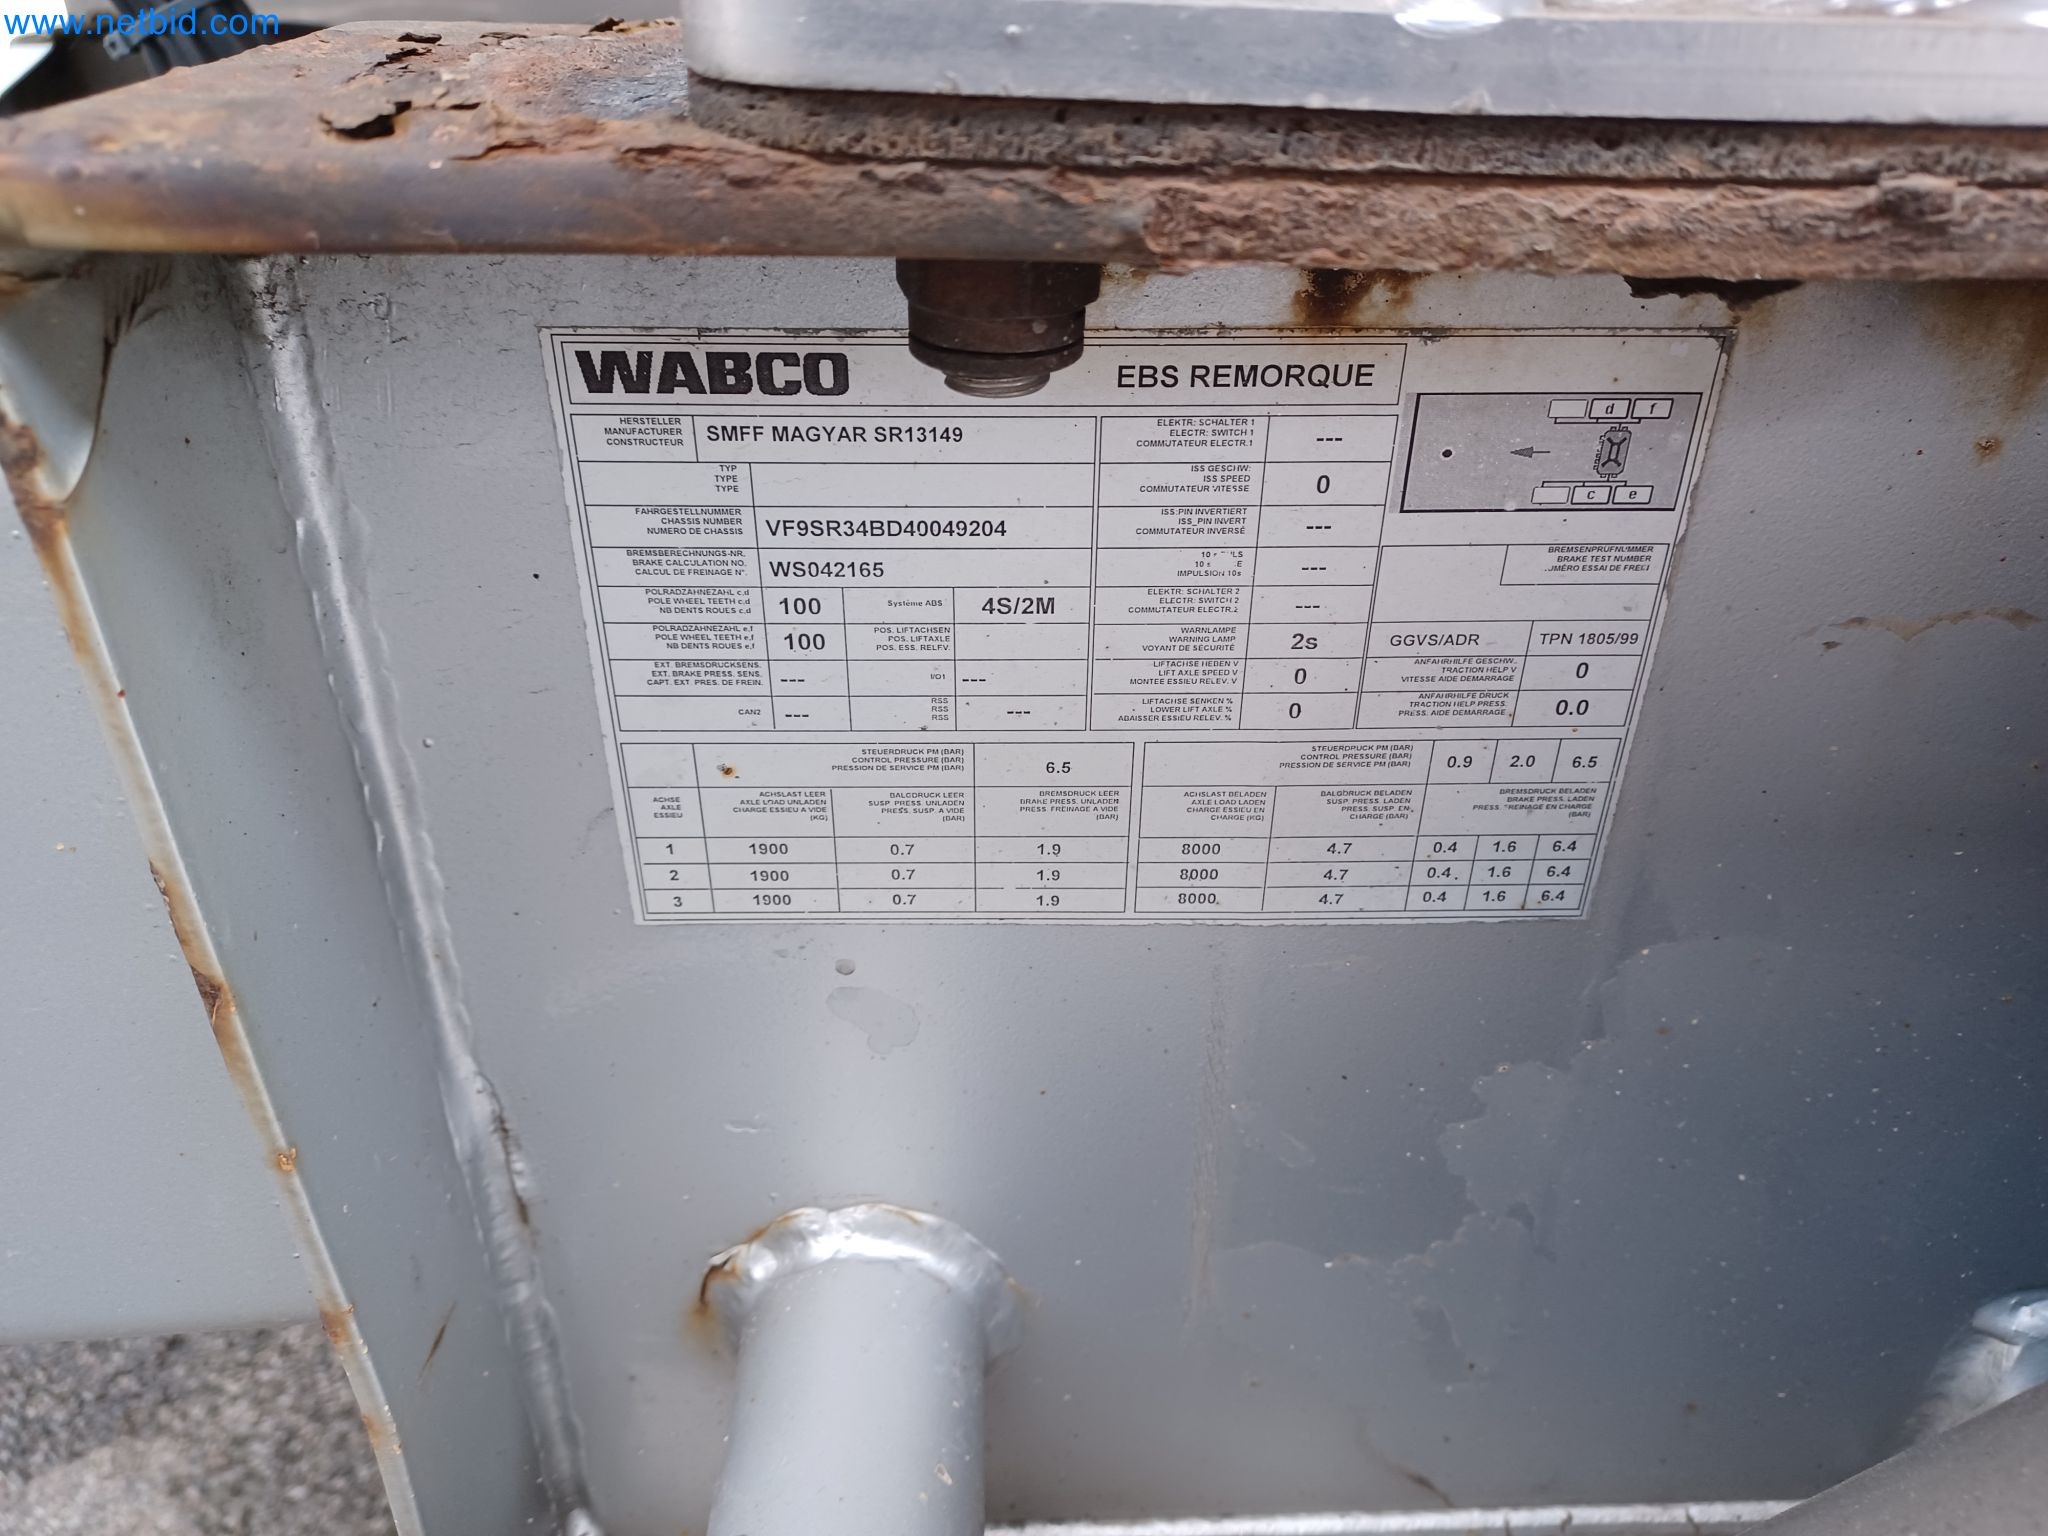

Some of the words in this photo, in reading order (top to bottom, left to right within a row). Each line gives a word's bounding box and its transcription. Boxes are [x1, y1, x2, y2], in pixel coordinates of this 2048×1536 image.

[574, 350, 850, 397] WABCO
[1116, 363, 1179, 390] EBS
[1190, 363, 1376, 390] REMORQUE
[1605, 402, 1614, 416] d
[619, 417, 682, 425] HERSTELLER
[1198, 418, 1248, 427] SCHALTER
[603, 427, 683, 436] MANUFACTURER
[706, 424, 764, 444] SMFF
[771, 424, 867, 444] MAGYAR
[874, 424, 964, 444] SR13149
[1210, 428, 1248, 437] SWITCH
[1135, 439, 1208, 448] COMMUTATEUR
[718, 464, 737, 473] TYP
[1190, 464, 1206, 473] ISS
[714, 474, 739, 483] TYPE
[1202, 474, 1218, 483] ISS
[1219, 474, 1251, 483] SPEED
[1316, 474, 1331, 494] 0
[715, 485, 740, 493] TYPE
[1139, 485, 1210, 493] COMMUTATEUR
[1586, 489, 1596, 501] c
[1628, 489, 1638, 500] e
[634, 507, 742, 516] FAHRGESTELLNUMMER
[1194, 507, 1248, 516] INVERTIERT
[660, 517, 701, 526] CHASSIS
[702, 517, 743, 526] NUMBER
[1213, 517, 1247, 527] INVERT
[703, 527, 744, 535] CHASSIS
[765, 519, 1008, 537] VF9SR34BD40049204
[1135, 525, 1205, 535] COMMUTATEUR
[632, 559, 664, 567] BRAKE
[1556, 555, 1588, 563] BRAKE
[1590, 555, 1611, 563] TEST
[1612, 555, 1652, 563] NUMBER
[634, 568, 671, 577] CALCUL
[687, 568, 733, 577] FREINAGE
[769, 561, 885, 578] WS042165
[1581, 563, 1608, 573] ESSAI
[647, 597, 672, 606] POLE
[672, 597, 705, 606] WHEEL
[707, 597, 736, 606] TEETH
[779, 597, 822, 616] 100
[981, 596, 1056, 616] 4S/2M
[673, 607, 704, 615] DENTS
[705, 607, 737, 615] ROUES
[895, 626, 951, 634] LIFTACHSEN
[1180, 626, 1237, 634] WARNLAMPE
[655, 634, 679, 642] POLE
[679, 634, 711, 642] WHEEL
[714, 634, 743, 642] TEETH
[783, 633, 826, 651] 100
[1168, 635, 1210, 643] WARNING
[1211, 635, 1236, 643] LAMP
[1290, 632, 1319, 651] 2s
[1389, 633, 1480, 647] GGVS/ADR
[1539, 632, 1573, 646] TPN
[1579, 632, 1639, 646] 1805/99
[680, 642, 710, 651] DENTS
[711, 642, 743, 651] ROUES
[1141, 642, 1176, 652] VOYANT
[671, 670, 702, 678] BRAKE
[1158, 669, 1176, 677] LIFT
[1177, 669, 1200, 677] AXLE
[1201, 669, 1231, 677] SPEED
[1294, 667, 1307, 685] 0
[1575, 662, 1589, 679] 0
[1437, 675, 1458, 683] AIDE
[1478, 691, 1510, 699] DRUCK
[737, 708, 762, 716] CAN2
[930, 705, 949, 713] RSS
[1150, 706, 1181, 714] LOWER
[1181, 706, 1200, 714] LIFT
[1201, 706, 1224, 714] AXLE
[1288, 702, 1302, 720] 0
[1430, 708, 1451, 717] AIDE
[1555, 699, 1590, 716] 0.0
[861, 748, 925, 757] STEUERDRUCK
[1300, 752, 1339, 761] CONTROL
[1341, 752, 1387, 761] PRESSURE
[851, 756, 891, 765] CONTROL
[893, 756, 939, 765] PRESSURE
[1446, 755, 1473, 768] 0.9
[1509, 755, 1536, 768] 2.0
[1571, 755, 1598, 769] 6.5
[831, 764, 875, 773] PRESSION
[888, 764, 925, 773] SERVICE
[1045, 761, 1072, 775] 6.5
[748, 843, 789, 855] 1900
[889, 843, 915, 856] 0.7
[1036, 843, 1061, 856] 1.9
[1181, 842, 1221, 856] 8000
[1326, 842, 1353, 855] 4.7
[1432, 841, 1458, 854] 0.4
[1492, 840, 1517, 853] 1.6
[1552, 840, 1577, 852] 6.4
[669, 869, 680, 881] 2
[749, 870, 790, 882] 1900
[890, 869, 916, 881] 0.7
[1035, 869, 1061, 882] 1.9
[1179, 868, 1219, 881] 8000
[1323, 869, 1349, 881] 4.7
[1426, 867, 1452, 879] 0.4
[1487, 866, 1512, 878] 1.6
[1545, 865, 1571, 877] 6.4
[672, 896, 683, 908] 3
[752, 894, 792, 906] 1900
[892, 894, 917, 906] 0.7
[1035, 894, 1060, 907] 1.9
[1177, 892, 1217, 905] 8000
[1318, 893, 1344, 906] 4.7
[1422, 891, 1447, 903] 0.4
[1482, 890, 1507, 902] 1.6
[1540, 890, 1566, 902] 6.4
